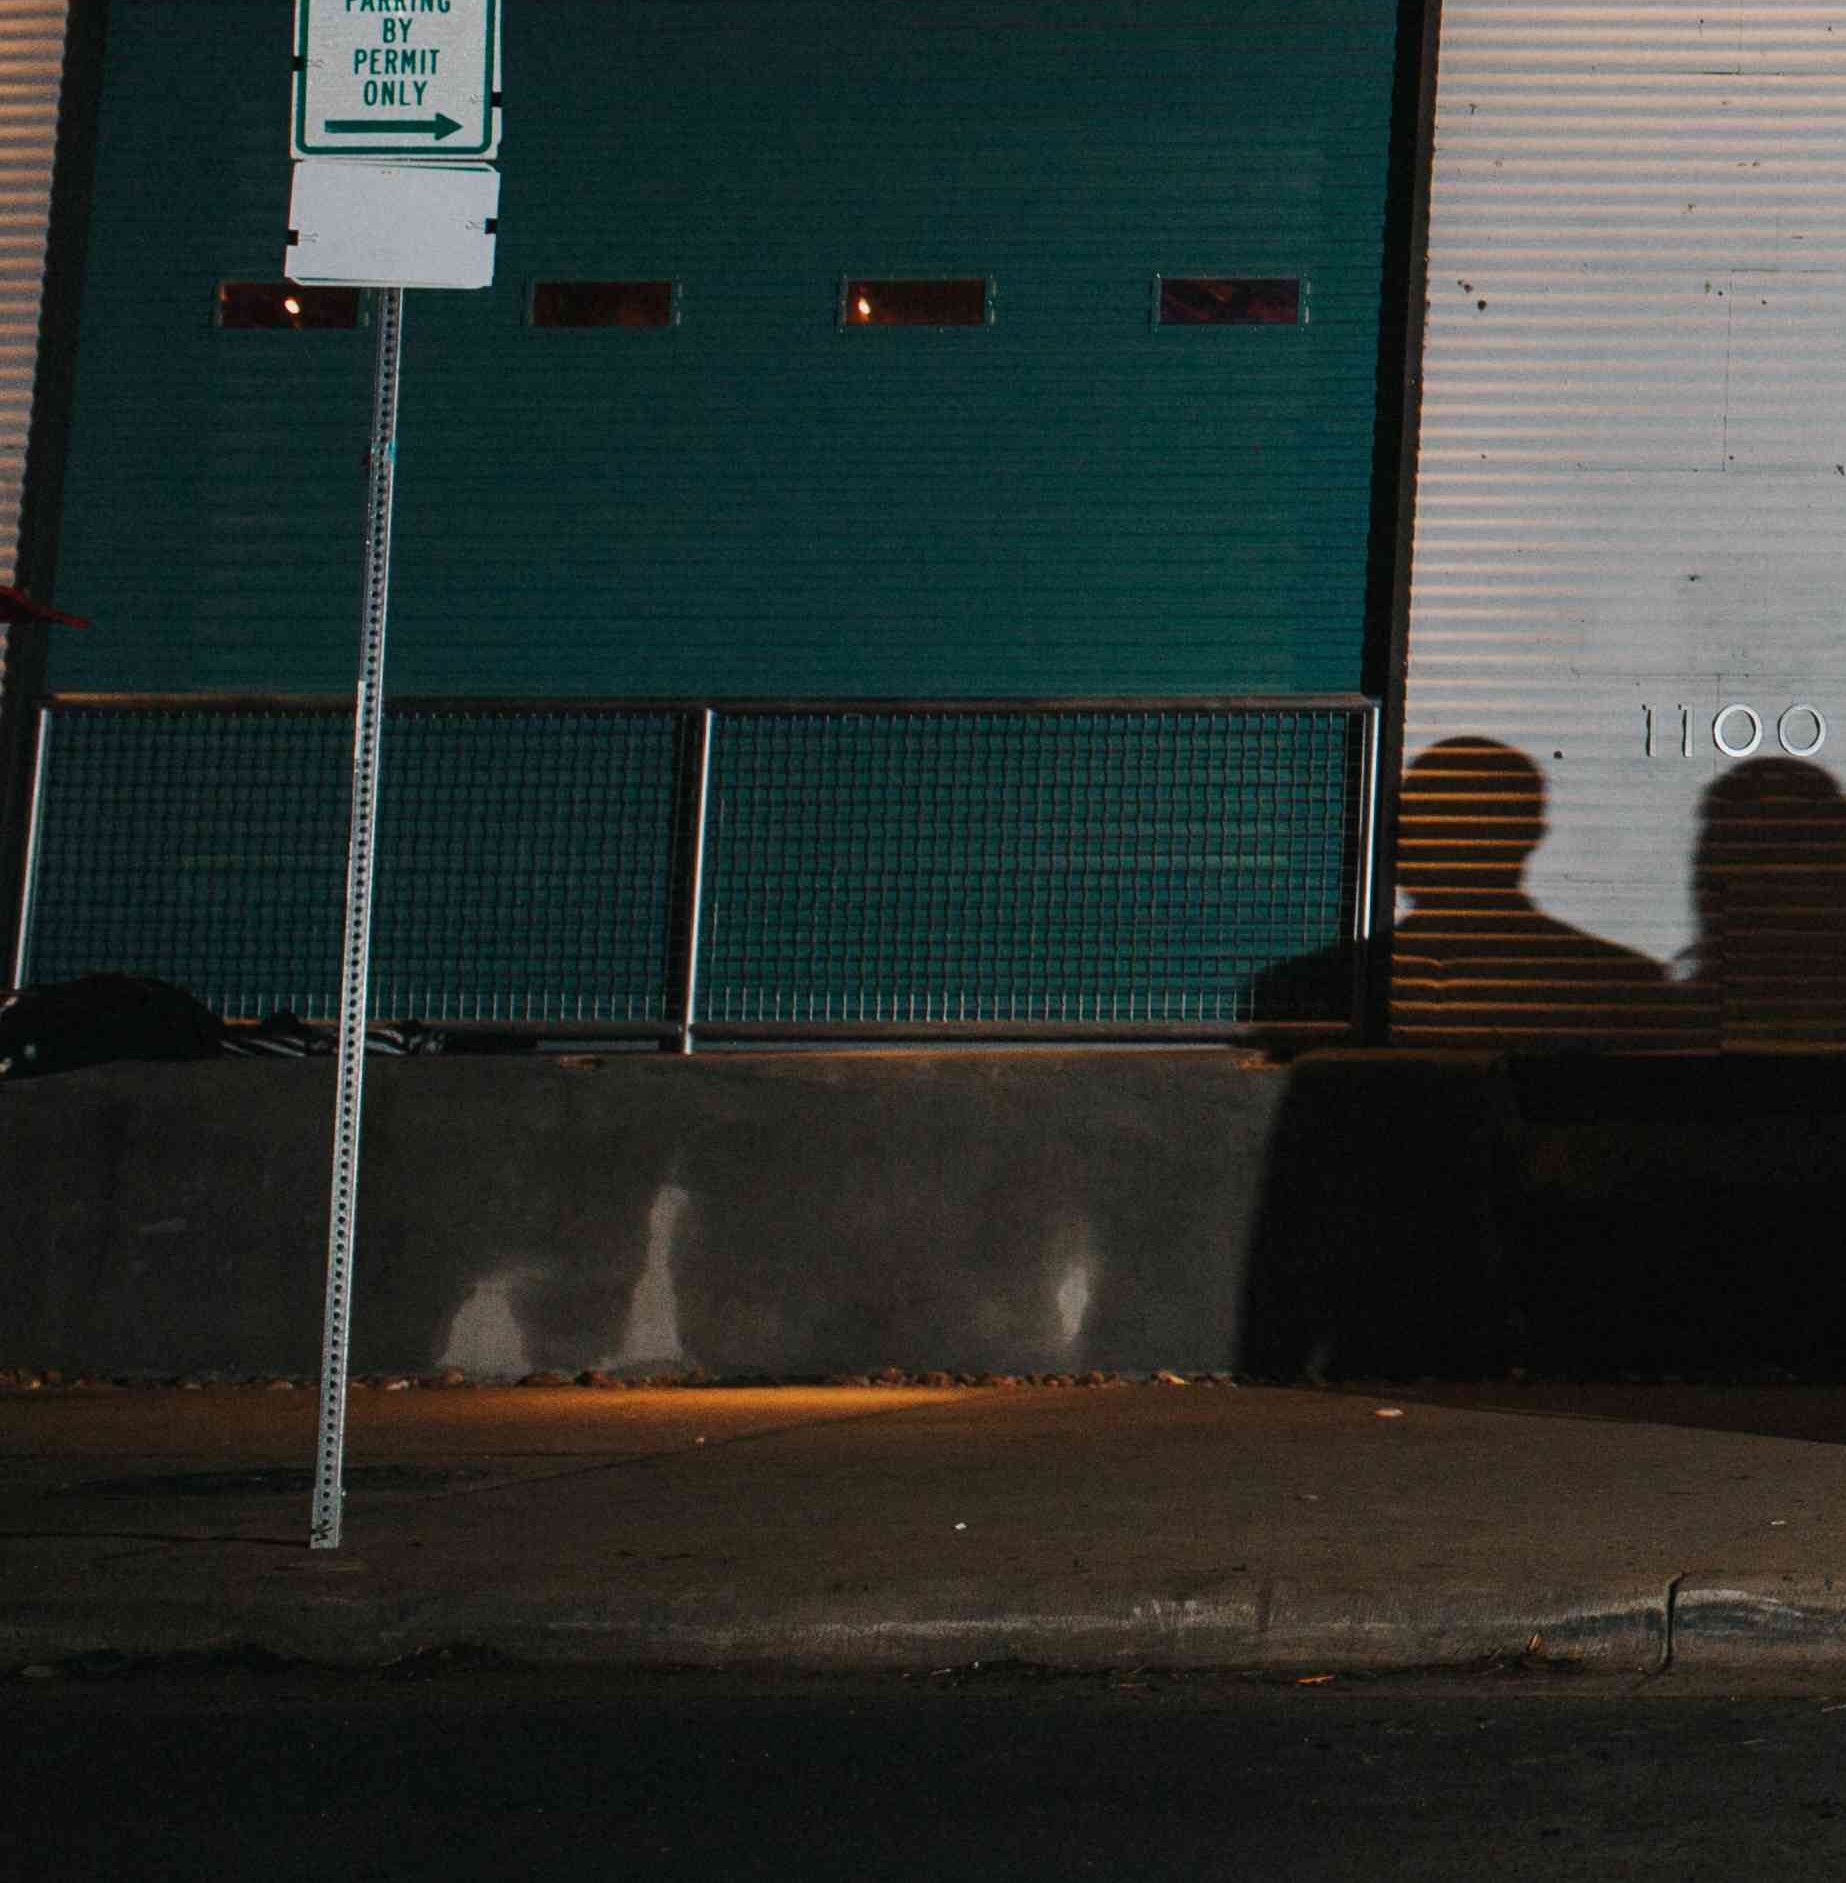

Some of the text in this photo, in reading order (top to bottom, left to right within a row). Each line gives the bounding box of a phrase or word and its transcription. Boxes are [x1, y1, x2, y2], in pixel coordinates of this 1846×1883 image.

[382, 19, 413, 44] BY
[353, 49, 440, 75] PERMIT
[363, 80, 428, 106] ONLY
[1642, 703, 1827, 758] 1100
